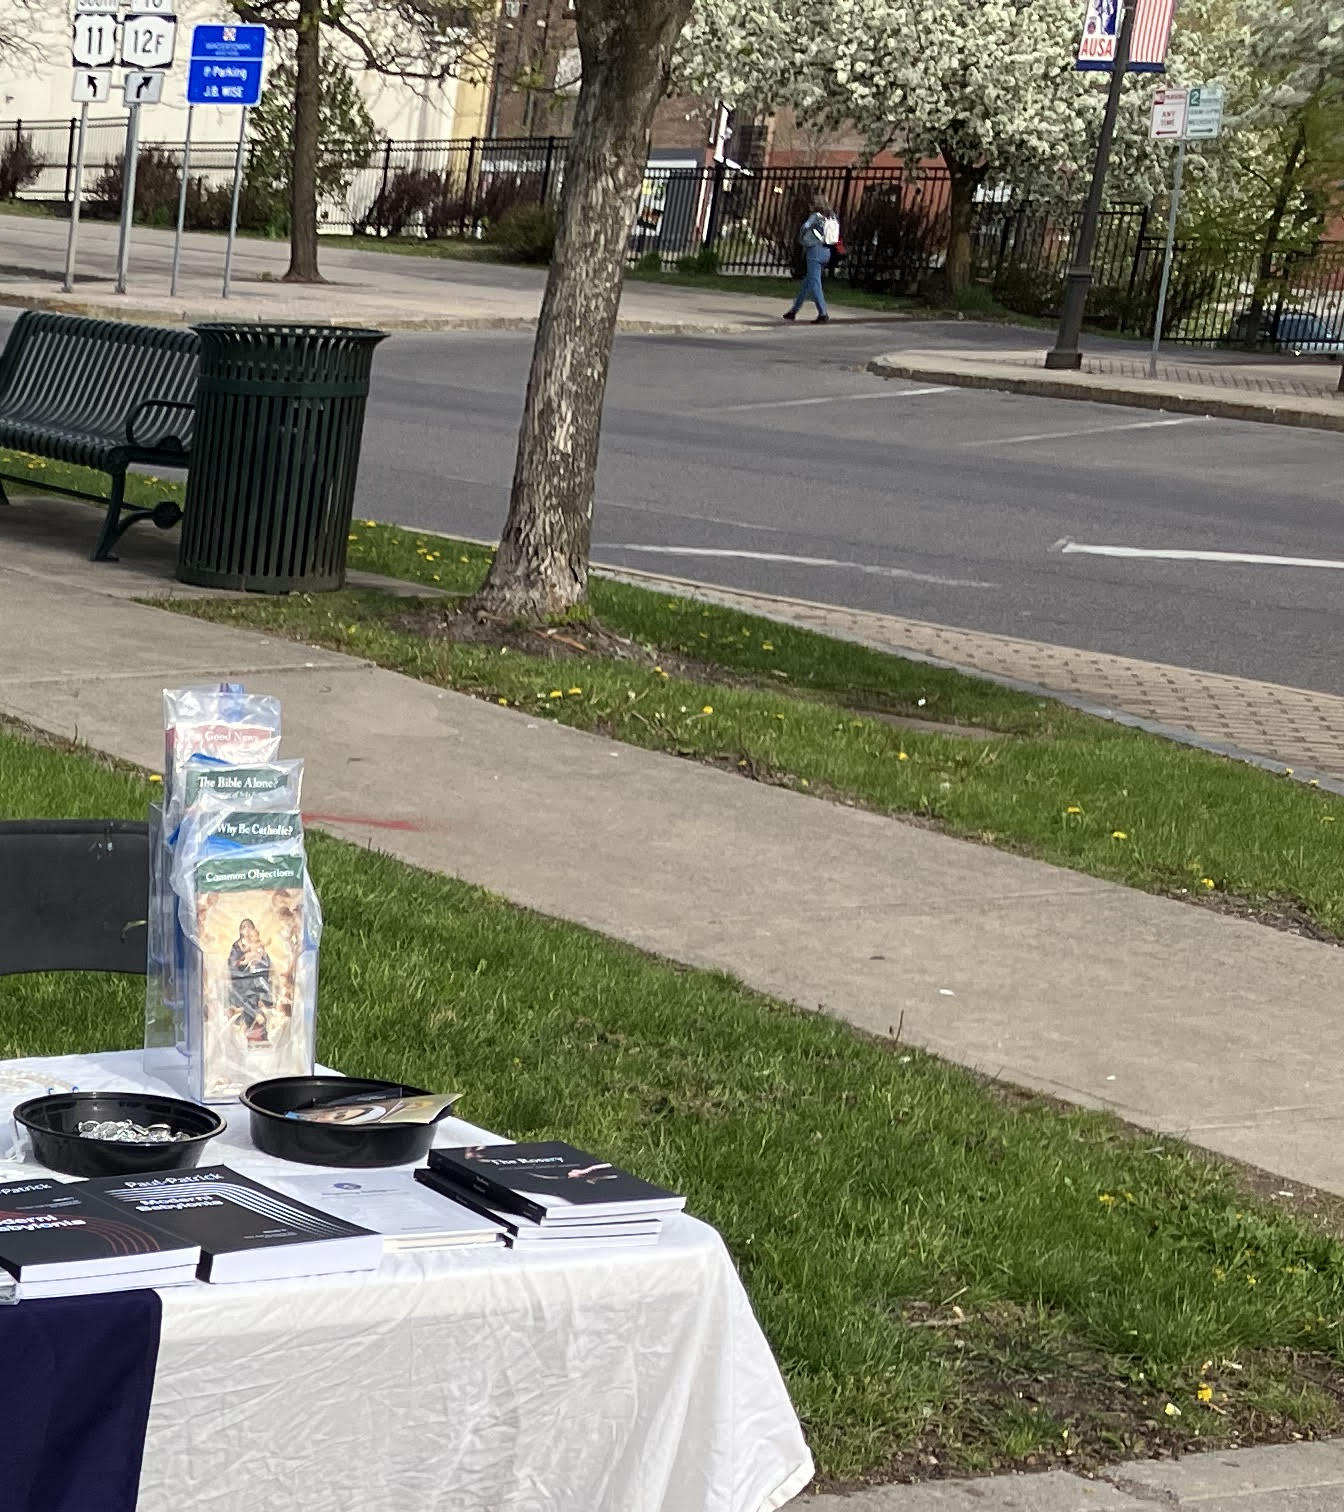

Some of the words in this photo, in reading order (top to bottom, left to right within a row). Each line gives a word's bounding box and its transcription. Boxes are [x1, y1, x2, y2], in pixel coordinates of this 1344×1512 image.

[87, 26, 104, 55] 11
[133, 29, 166, 55] 12F
[1079, 37, 1113, 58] AUSA
[198, 776, 216, 788] The
[217, 777, 242, 788] Bible
[244, 776, 278, 789] Alone?
[217, 824, 237, 838] Why
[251, 823, 294, 836] Catholic?
[205, 870, 247, 882] Common
[247, 867, 295, 881] Objections
[490, 1157, 517, 1166] The
[519, 1156, 564, 1166] Rosary
[124, 1172, 226, 1189] Paul-Patrick
